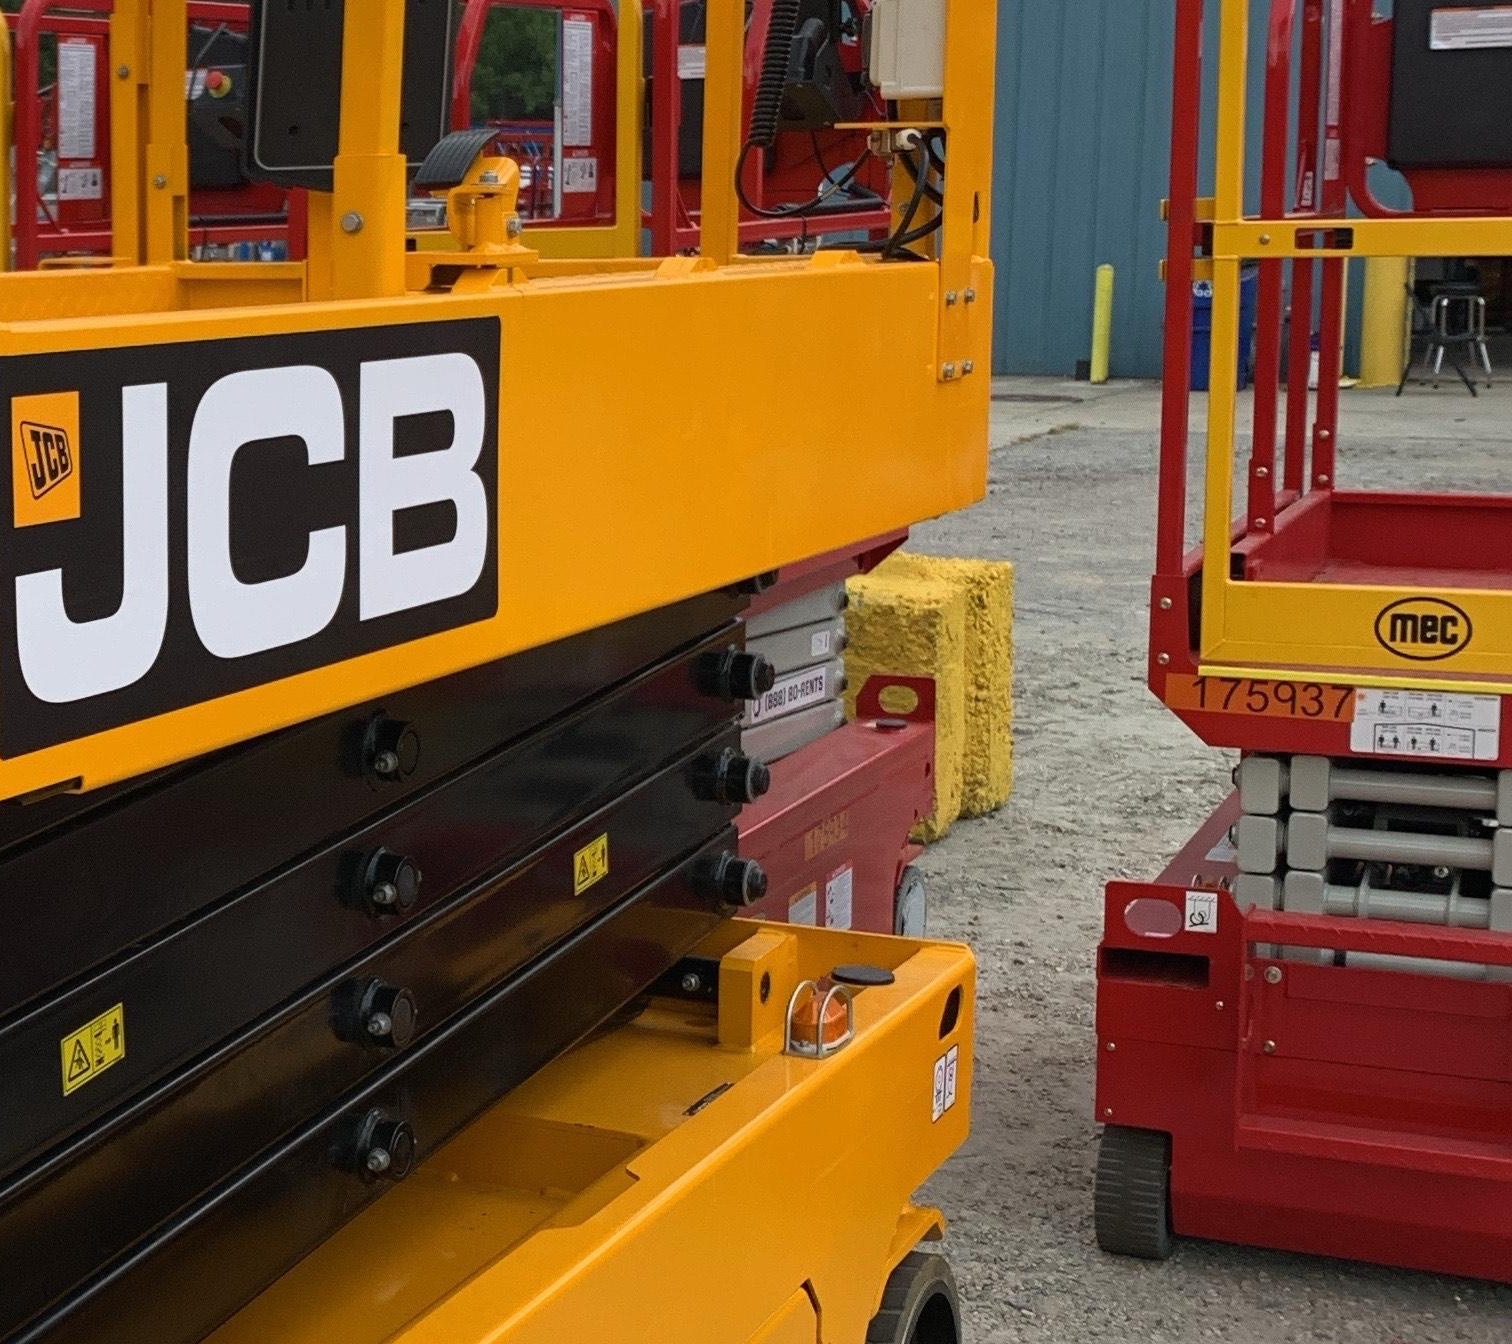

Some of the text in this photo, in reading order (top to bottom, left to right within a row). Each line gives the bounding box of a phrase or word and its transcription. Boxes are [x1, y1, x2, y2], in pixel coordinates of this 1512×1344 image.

[29, 430, 70, 489] JCB
[15, 352, 488, 704] JCB
[1389, 613, 1459, 645] mec
[1191, 676, 1354, 719] 175937
